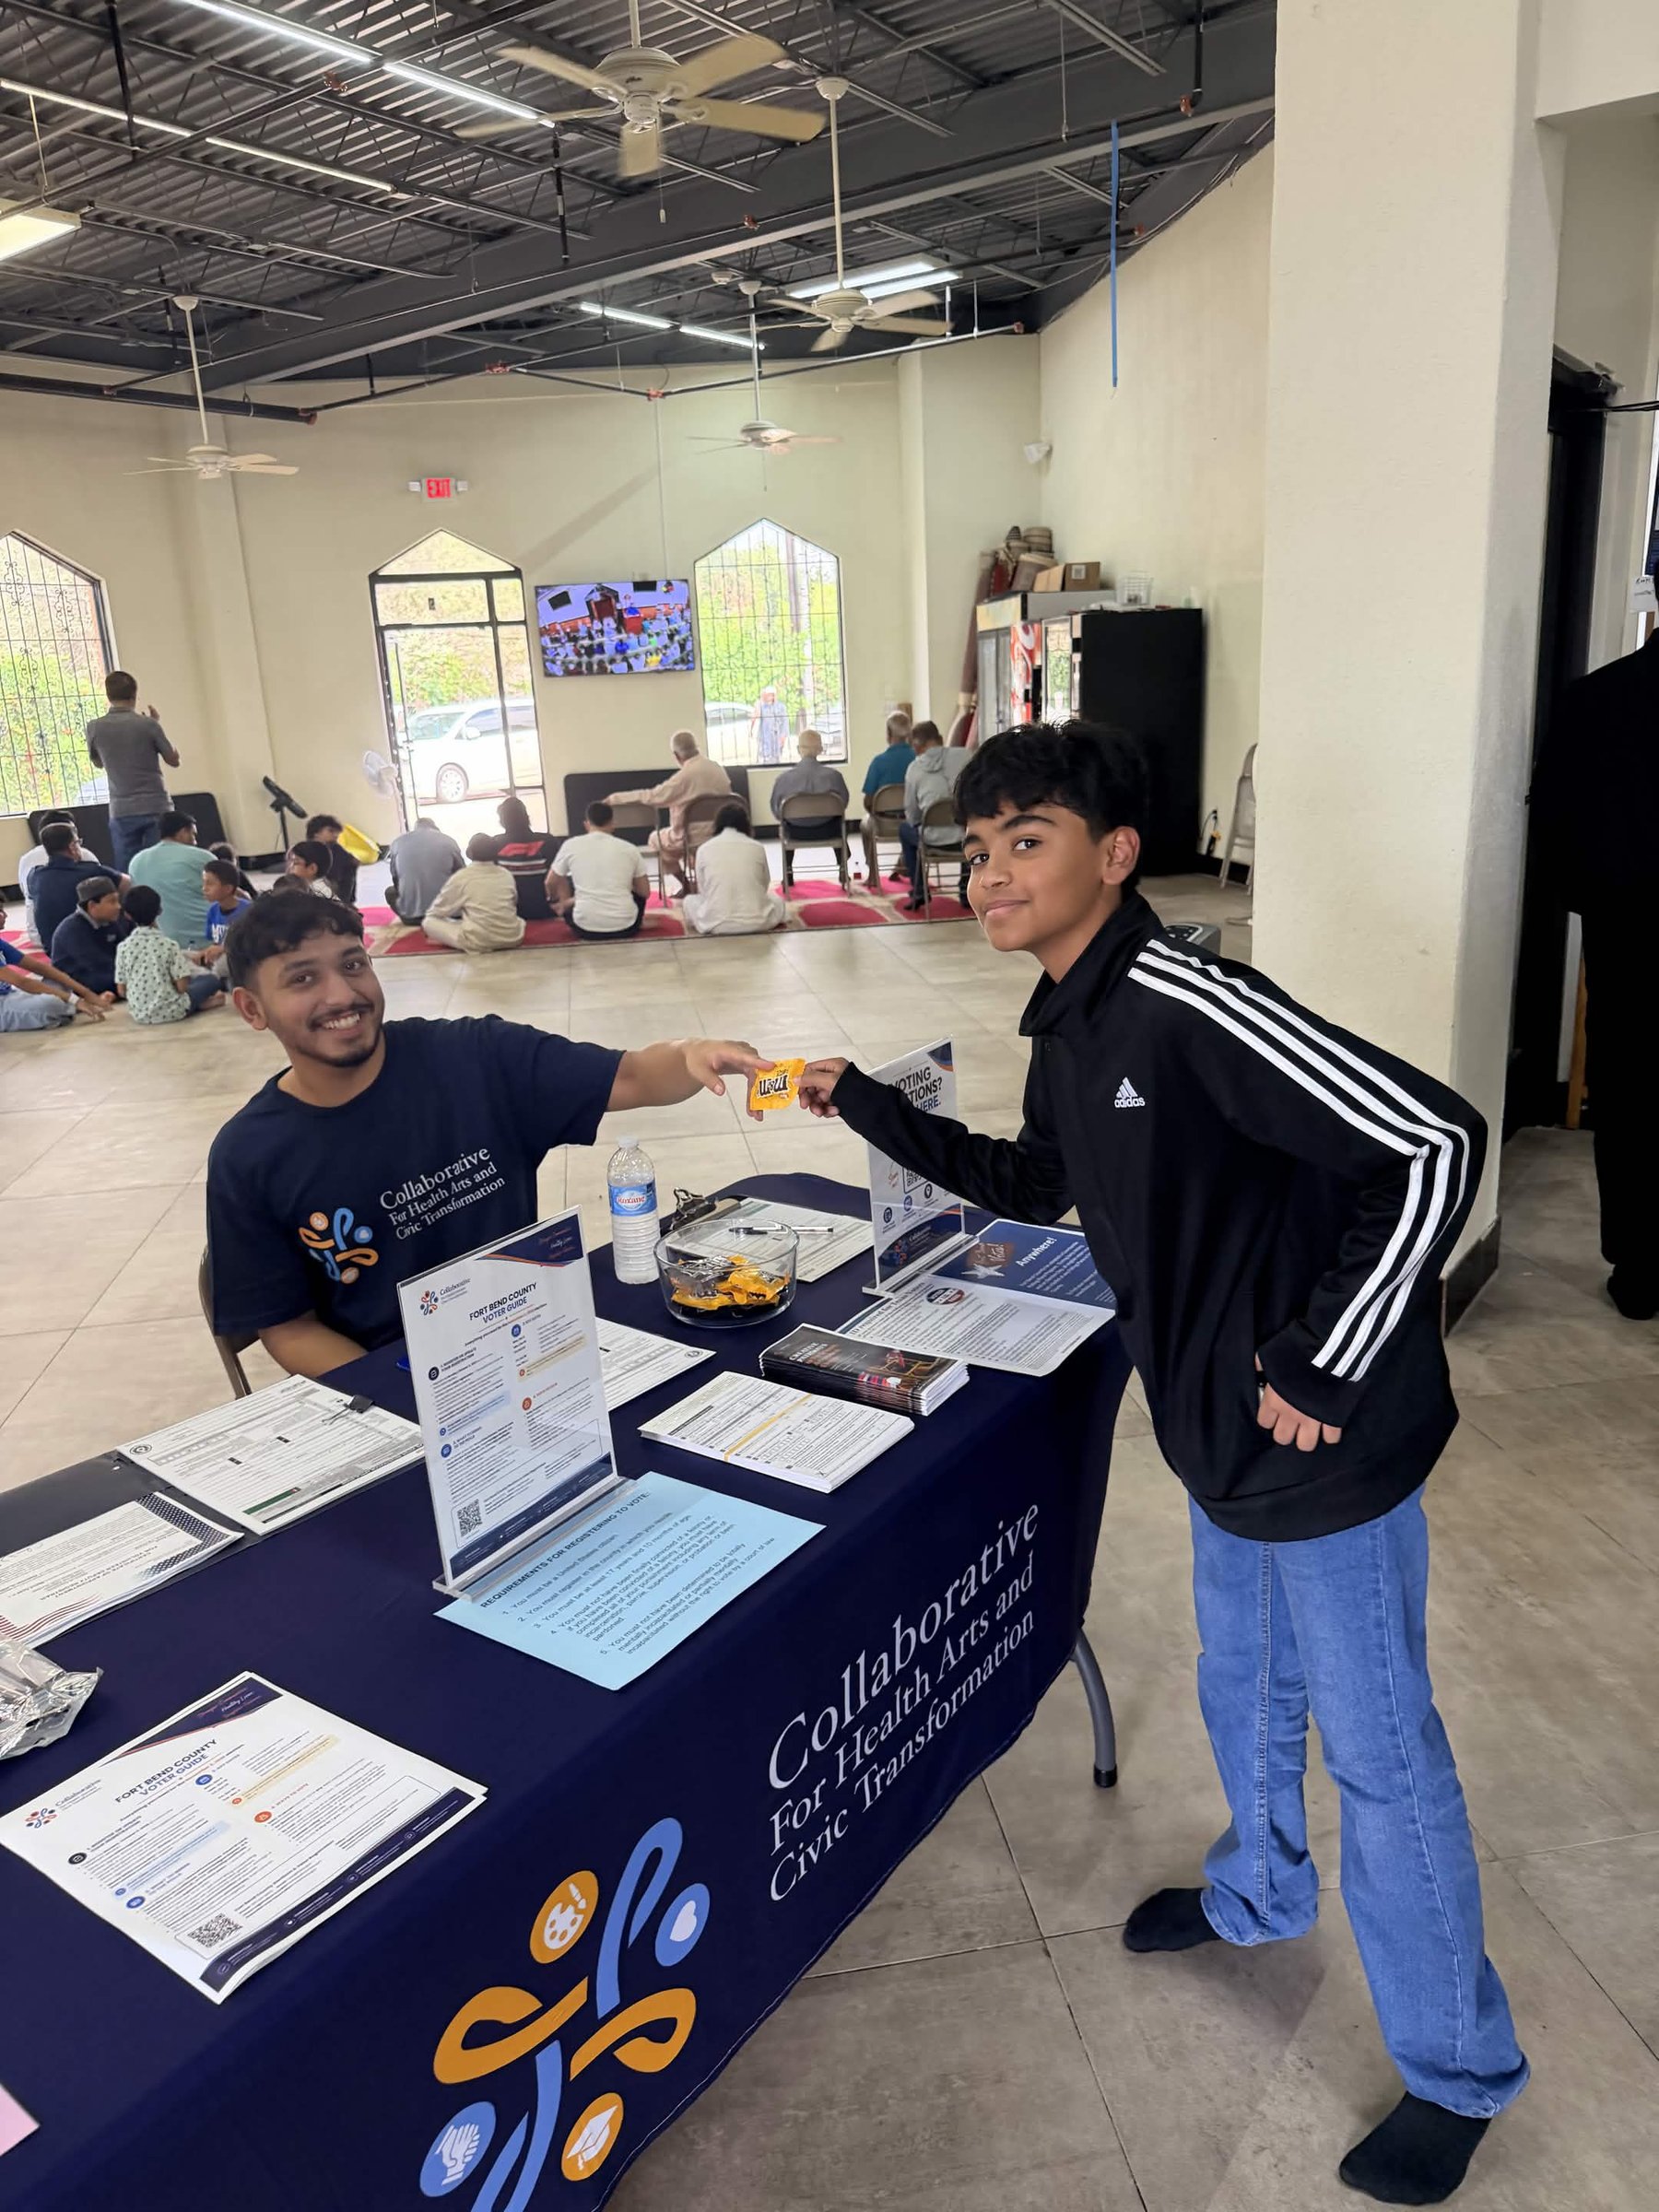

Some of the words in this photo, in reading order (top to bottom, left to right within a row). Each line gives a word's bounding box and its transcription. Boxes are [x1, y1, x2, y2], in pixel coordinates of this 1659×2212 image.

[895, 1066, 931, 1091] OTING
[1114, 1097, 1146, 1108] adidas
[380, 1148, 491, 1210] Collaborative
[388, 1209, 408, 1227] For
[407, 1187, 449, 1218] Health
[451, 1178, 472, 1196] Arts
[475, 1162, 498, 1183] and
[396, 1221, 422, 1241] Civic
[420, 1177, 506, 1228] Transformation
[1015, 1236, 1058, 1267] Anywhere!
[469, 1305, 489, 1321] FORT
[488, 1297, 508, 1315] BEND
[508, 1282, 538, 1305] COUNTY
[482, 1307, 507, 1324] VOTER
[507, 1297, 528, 1312] GUIDE
[482, 1562, 547, 1606] REQUIREMENTS
[547, 1549, 566, 1561] FOR
[565, 1515, 616, 1548] REGISTERING
[769, 1504, 1039, 1790] Collaborative
[770, 1776, 826, 1856] For
[835, 1669, 931, 1789] Health
[935, 1608, 988, 1684] Arts
[995, 1550, 1034, 1620] and
[115, 1784, 144, 1803] FORT
[144, 1767, 174, 1785] BEND
[174, 1739, 218, 1768] COUNTY
[139, 1773, 177, 1796] VOTER
[176, 1754, 208, 1774] GUIDE
[770, 1808, 849, 1902] Civic
[853, 1609, 1034, 1813] Transformation
